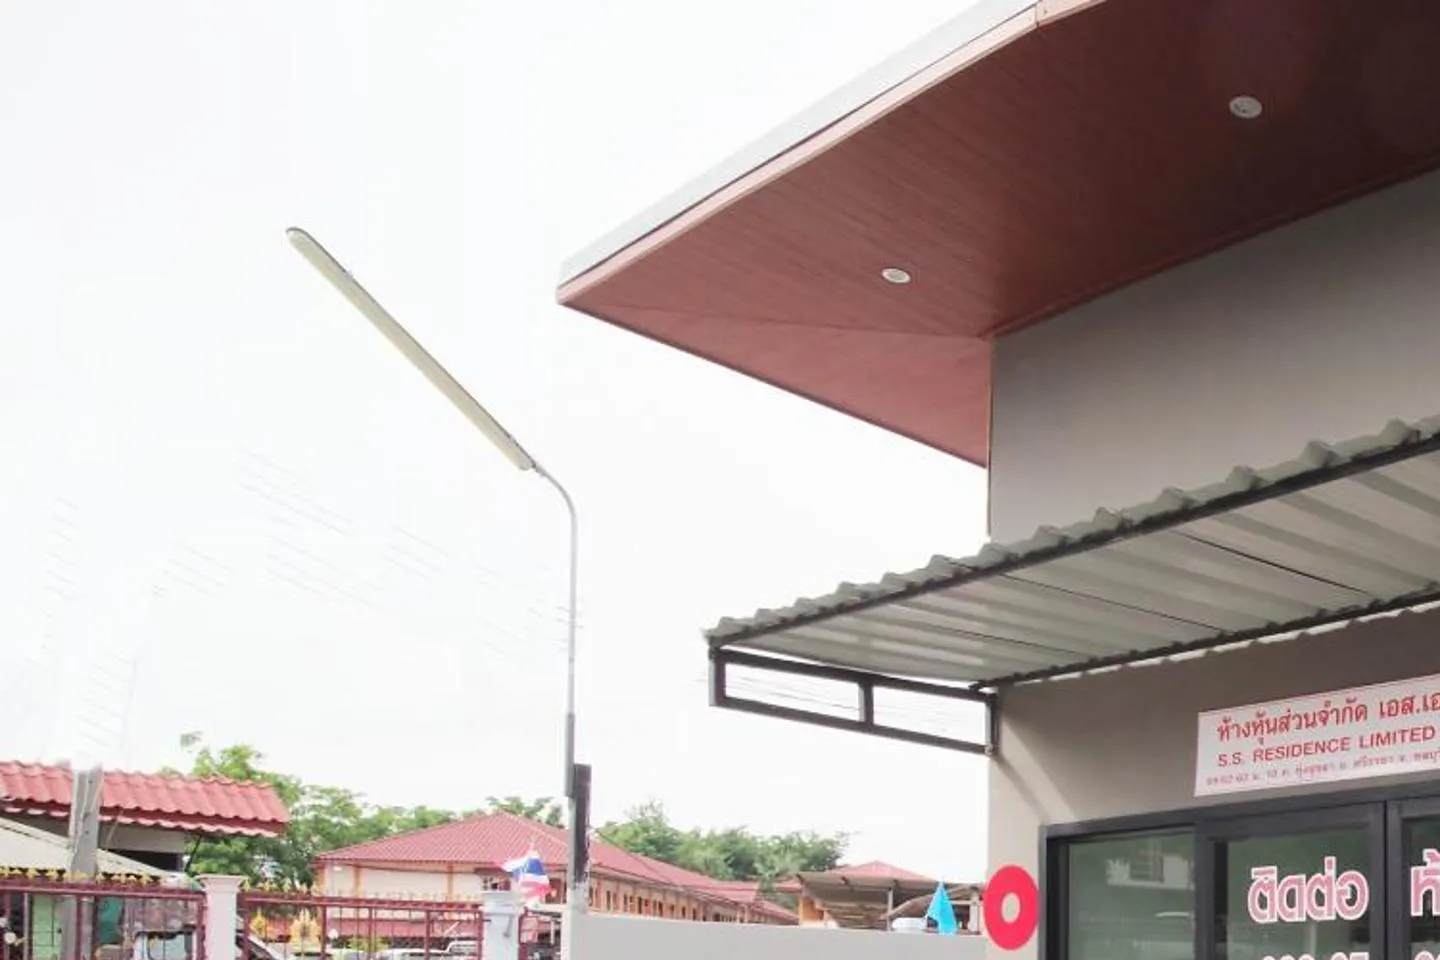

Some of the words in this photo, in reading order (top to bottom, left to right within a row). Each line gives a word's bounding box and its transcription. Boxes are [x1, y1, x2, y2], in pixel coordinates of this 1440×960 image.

[1217, 697, 1368, 745] ห้างหุ้นส่วนจำกัด
[1217, 751, 1245, 768] S.S.
[1252, 737, 1351, 763] RESIDENCE
[1359, 726, 1436, 749] LIMITED
[1248, 856, 1369, 923] ติดต่อ
